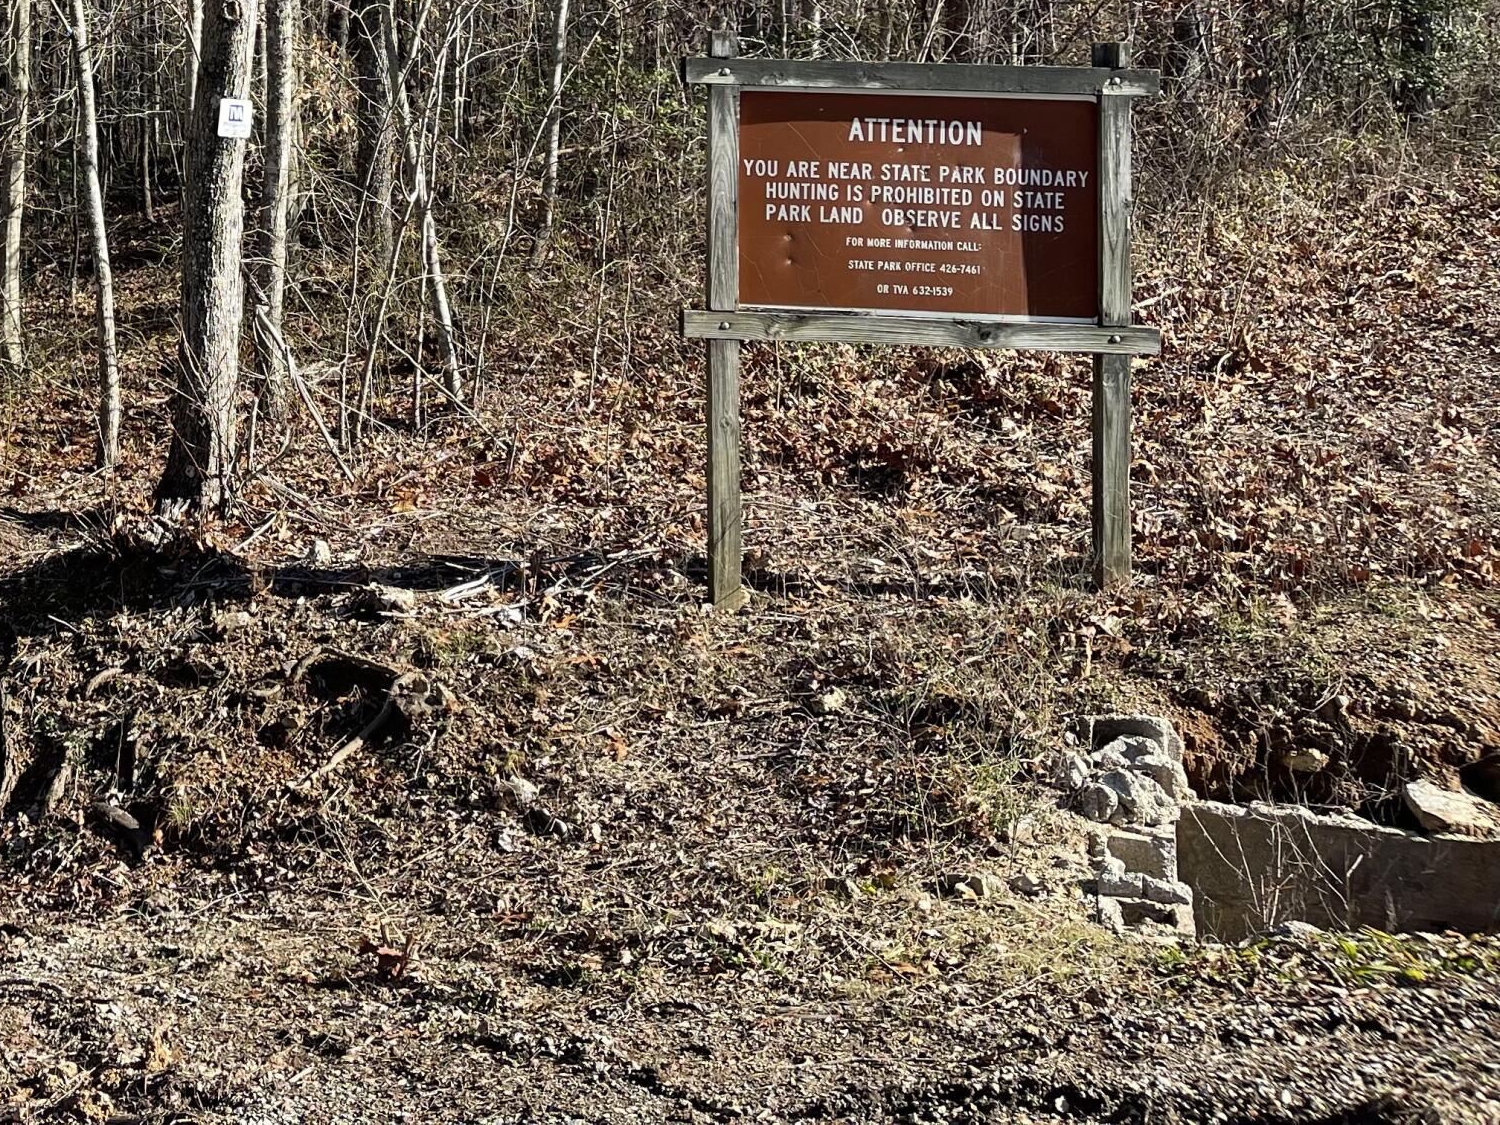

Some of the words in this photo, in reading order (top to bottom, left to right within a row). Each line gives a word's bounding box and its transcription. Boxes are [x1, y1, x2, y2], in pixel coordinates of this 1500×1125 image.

[848, 117, 982, 146] ATTENTION
[743, 159, 778, 177] YOU
[786, 161, 820, 178] ARE
[828, 162, 873, 180] NEAR
[880, 163, 931, 182] STATE
[939, 166, 985, 184] PARK
[994, 168, 1089, 187] BOUNDARY
[765, 182, 839, 201] HUNTING
[846, 185, 863, 202] IS
[871, 186, 972, 206] PROHIBITED
[981, 190, 1005, 207] ON
[1013, 191, 1065, 209] STATE
[765, 204, 812, 222] PARK
[820, 206, 863, 224] LAND
[882, 209, 961, 229] OBSERVE
[970, 213, 1003, 230] ALL
[1011, 214, 1065, 233] SIGNS
[845, 237, 864, 247] FOR
[867, 238, 891, 248] MORE
[894, 239, 953, 251] INFORMATION
[956, 242, 982, 252] CALL:
[848, 260, 874, 270] STATE
[877, 261, 901, 271] PARK
[905, 262, 936, 273] OFFICE
[939, 264, 981, 275] 426-7461
[876, 284, 889, 294] OR
[893, 285, 909, 295] TVA
[912, 286, 954, 296] 632-1539
